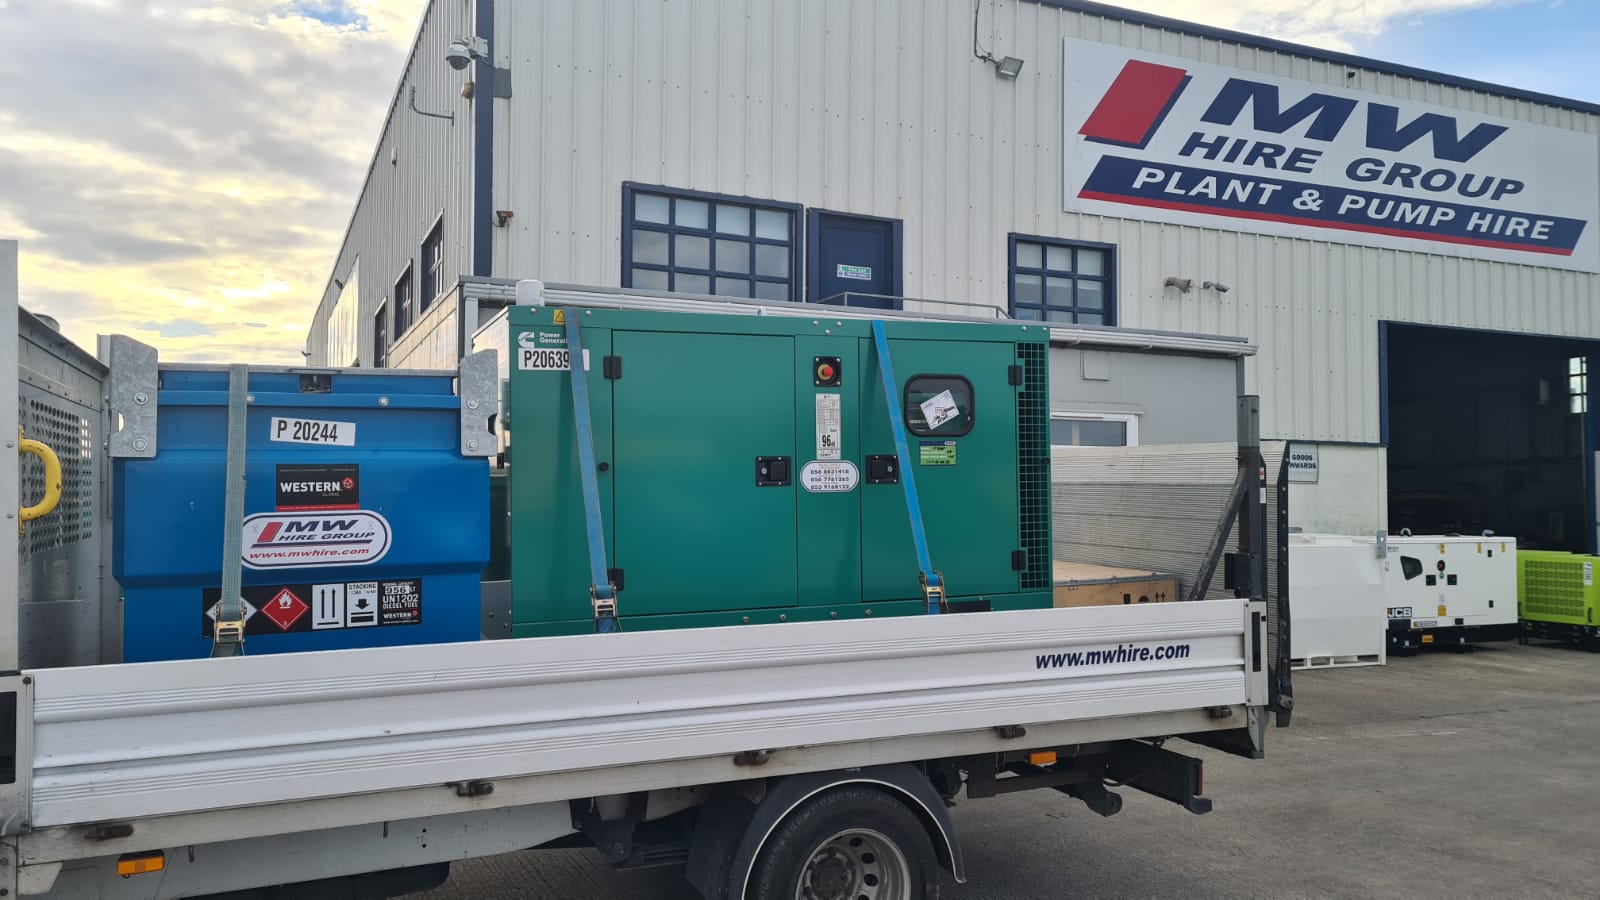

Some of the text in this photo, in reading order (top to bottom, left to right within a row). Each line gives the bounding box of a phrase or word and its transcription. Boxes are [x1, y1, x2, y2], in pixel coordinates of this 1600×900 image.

[1200, 78, 1510, 163] MW
[1178, 132, 1526, 202] HIRE GROUP
[1131, 166, 1556, 241] PLANT & PUMP HIRE
[524, 350, 570, 368] P20639
[277, 419, 338, 443] P 20244
[822, 434, 831, 447] 96
[280, 481, 341, 493] WESTERN
[284, 519, 359, 533] MW
[278, 530, 376, 542] HIRE GROUP
[249, 547, 370, 560] www.mwhire.com
[386, 586, 407, 594] 956
[382, 594, 419, 604] UN1202
[1387, 608, 1412, 617] JCB
[1035, 643, 1190, 669] www.mwhire.com
